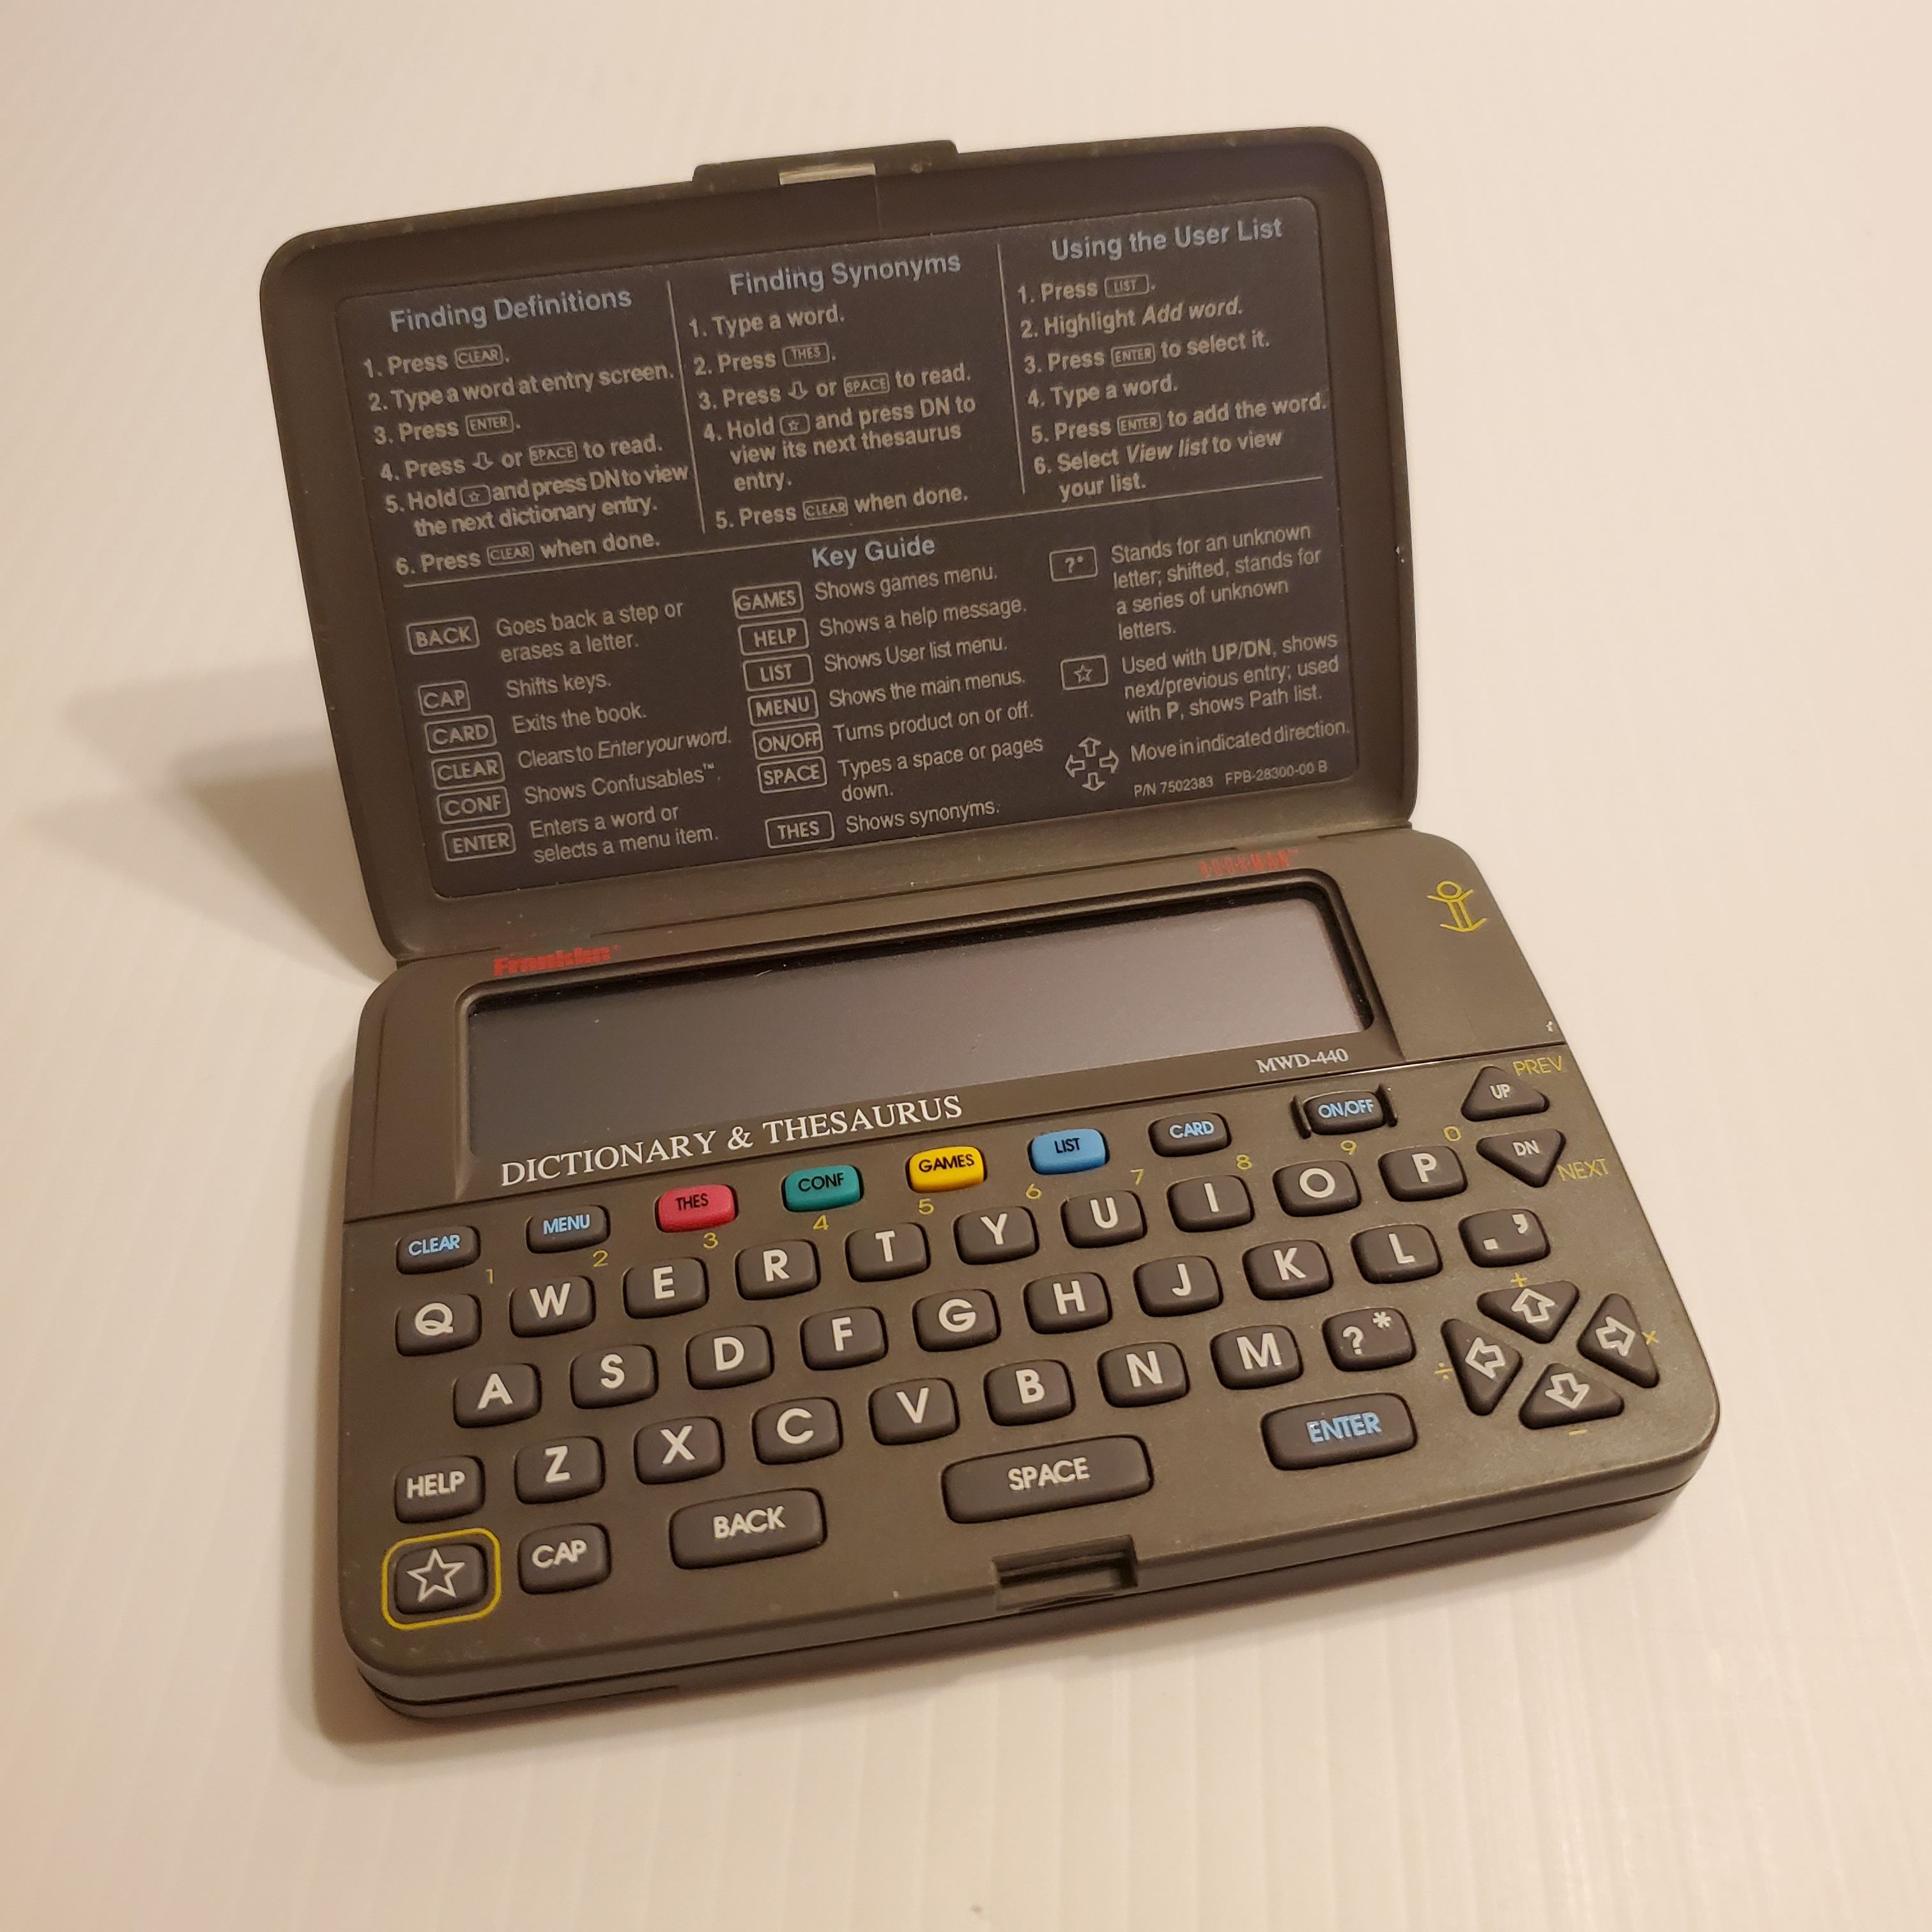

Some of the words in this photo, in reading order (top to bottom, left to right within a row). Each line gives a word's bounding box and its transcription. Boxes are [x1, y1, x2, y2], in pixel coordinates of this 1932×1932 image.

[1051, 236, 1122, 261] Using
[1129, 231, 1167, 252] the
[1175, 226, 1229, 248] User
[1238, 218, 1283, 242] List
[730, 267, 824, 295] Finding
[832, 255, 961, 289] Synonyms
[390, 305, 487, 333] Finding
[494, 288, 632, 319] Definitions
[689, 319, 707, 338] 1.
[712, 313, 763, 339] Type
[770, 314, 781, 329] a
[786, 304, 845, 327] word.
[1021, 320, 1038, 339] 2.
[1044, 309, 1135, 338] Highlight
[1142, 302, 1183, 325] Add
[1189, 296, 1243, 318] word.
[369, 394, 388, 412] 2.
[392, 389, 444, 412] Type
[447, 388, 459, 401] a
[463, 379, 514, 401] word
[519, 377, 538, 394] at
[542, 370, 594, 393] entry
[599, 363, 675, 385] screen.
[1027, 390, 1045, 408] 4.
[1050, 383, 1100, 408] Type
[1106, 385, 1117, 399] a
[1123, 374, 1178, 396] word.
[730, 444, 775, 465] view
[783, 440, 807, 458] its
[813, 434, 857, 456] next
[861, 424, 962, 449] thesaurus
[734, 471, 792, 491] entry.
[1059, 478, 1104, 503] your
[1110, 472, 1146, 493] list.
[415, 518, 447, 538] the
[452, 511, 494, 532] next
[499, 500, 596, 527] dictionary
[602, 496, 658, 520] entry.
[812, 546, 857, 569] Key
[864, 534, 936, 562] Guide
[815, 578, 875, 601] Shows
[880, 571, 939, 597] games
[944, 564, 998, 585] menu.
[736, 590, 797, 611] GAMES
[496, 617, 546, 637] Goes
[551, 611, 597, 631] back
[603, 611, 614, 625] a
[620, 604, 658, 625] step
[664, 601, 683, 618] or
[1119, 620, 1176, 640] letters.
[415, 626, 471, 648] BACK
[753, 627, 797, 648] HELP
[824, 650, 882, 672] Shows
[885, 643, 926, 664] User
[930, 640, 953, 659] list
[956, 635, 1008, 656] menu.
[506, 677, 558, 698] Shifts
[563, 671, 612, 694] keys.
[760, 664, 792, 683] LIST
[1124, 669, 1238, 700] next/previous
[1243, 663, 1292, 684] entry;
[1297, 656, 1338, 677] used
[422, 690, 465, 710] CAP
[755, 696, 810, 718] MENU
[512, 714, 557, 734] Exits
[561, 709, 591, 728] the
[598, 702, 647, 723] book.
[833, 721, 885, 743] Turns
[889, 710, 953, 740] product
[959, 710, 979, 726] on
[985, 707, 1002, 723] or
[1008, 700, 1034, 720] off.
[432, 724, 489, 746] CARD
[758, 730, 821, 753] ON/OFF
[1130, 740, 1177, 762] Move
[1179, 738, 1194, 754] in
[1197, 726, 1271, 753] indicated
[1275, 719, 1350, 744] direction.
[437, 760, 498, 782] CLEAR
[763, 765, 820, 785] SPACE
[1134, 781, 1156, 797] P/N
[1160, 776, 1214, 795] 7502383
[1318, 760, 1328, 772] B
[444, 795, 502, 816] CONF
[841, 781, 893, 802] down.
[777, 821, 820, 840] THES
[846, 811, 905, 833] Shows
[910, 799, 1000, 825] synonyms.
[453, 833, 510, 854] ENTER
[1255, 1048, 1349, 1075] MWD-440
[1512, 1056, 1564, 1077] PREV
[1491, 1083, 1511, 1100] UP
[1318, 1098, 1374, 1119] ON/OFF
[500, 1130, 717, 1188] DICTIONARY
[726, 1125, 754, 1151] &
[763, 1093, 962, 1145] THESAURUS
[1169, 1119, 1215, 1139] CARD
[1445, 1126, 1462, 1141] 0
[1054, 1138, 1080, 1153] LIST
[1341, 1140, 1358, 1156] 9
[1512, 1140, 1540, 1156] DN
[918, 1153, 975, 1173] GAMES
[1130, 1169, 1144, 1184] 7
[1236, 1154, 1252, 1170] 8
[1412, 1153, 1438, 1183] P
[1557, 1158, 1609, 1183] NEXT
[798, 1173, 844, 1193] CONF
[1026, 1184, 1041, 1200] 6
[1204, 1183, 1219, 1213] I
[1300, 1168, 1335, 1198] O
[675, 1193, 709, 1211] THES
[918, 1199, 934, 1215] 5
[1091, 1197, 1119, 1229] U
[543, 1215, 590, 1234] MENU
[813, 1215, 829, 1230] 4
[980, 1213, 1008, 1245] Y
[408, 1234, 460, 1256] CLEAR
[703, 1233, 718, 1248] 3
[875, 1230, 895, 1262] T
[1388, 1233, 1414, 1264] L
[592, 1250, 608, 1268] 2
[763, 1249, 789, 1282] R
[1275, 1246, 1306, 1280] K
[486, 1268, 493, 1284] 1
[653, 1266, 675, 1300] E
[1172, 1264, 1193, 1296] J
[530, 1283, 571, 1319] W
[1053, 1280, 1085, 1314] H
[415, 1303, 454, 1337] Q
[939, 1299, 976, 1333] G
[831, 1317, 854, 1352] F
[714, 1336, 744, 1371] D
[1237, 1332, 1282, 1370] M
[600, 1354, 625, 1389] S
[1126, 1350, 1163, 1387] N
[478, 1374, 513, 1410] A
[1015, 1369, 1045, 1404] B
[896, 1387, 929, 1424] V
[776, 1408, 813, 1445] C
[1306, 1411, 1382, 1444] ENTER
[660, 1425, 696, 1465] X
[545, 1446, 571, 1483] Z
[1008, 1457, 1090, 1492] SPACE
[406, 1471, 464, 1499] HELP
[713, 1505, 786, 1539] BACK
[531, 1539, 586, 1568] CAP
